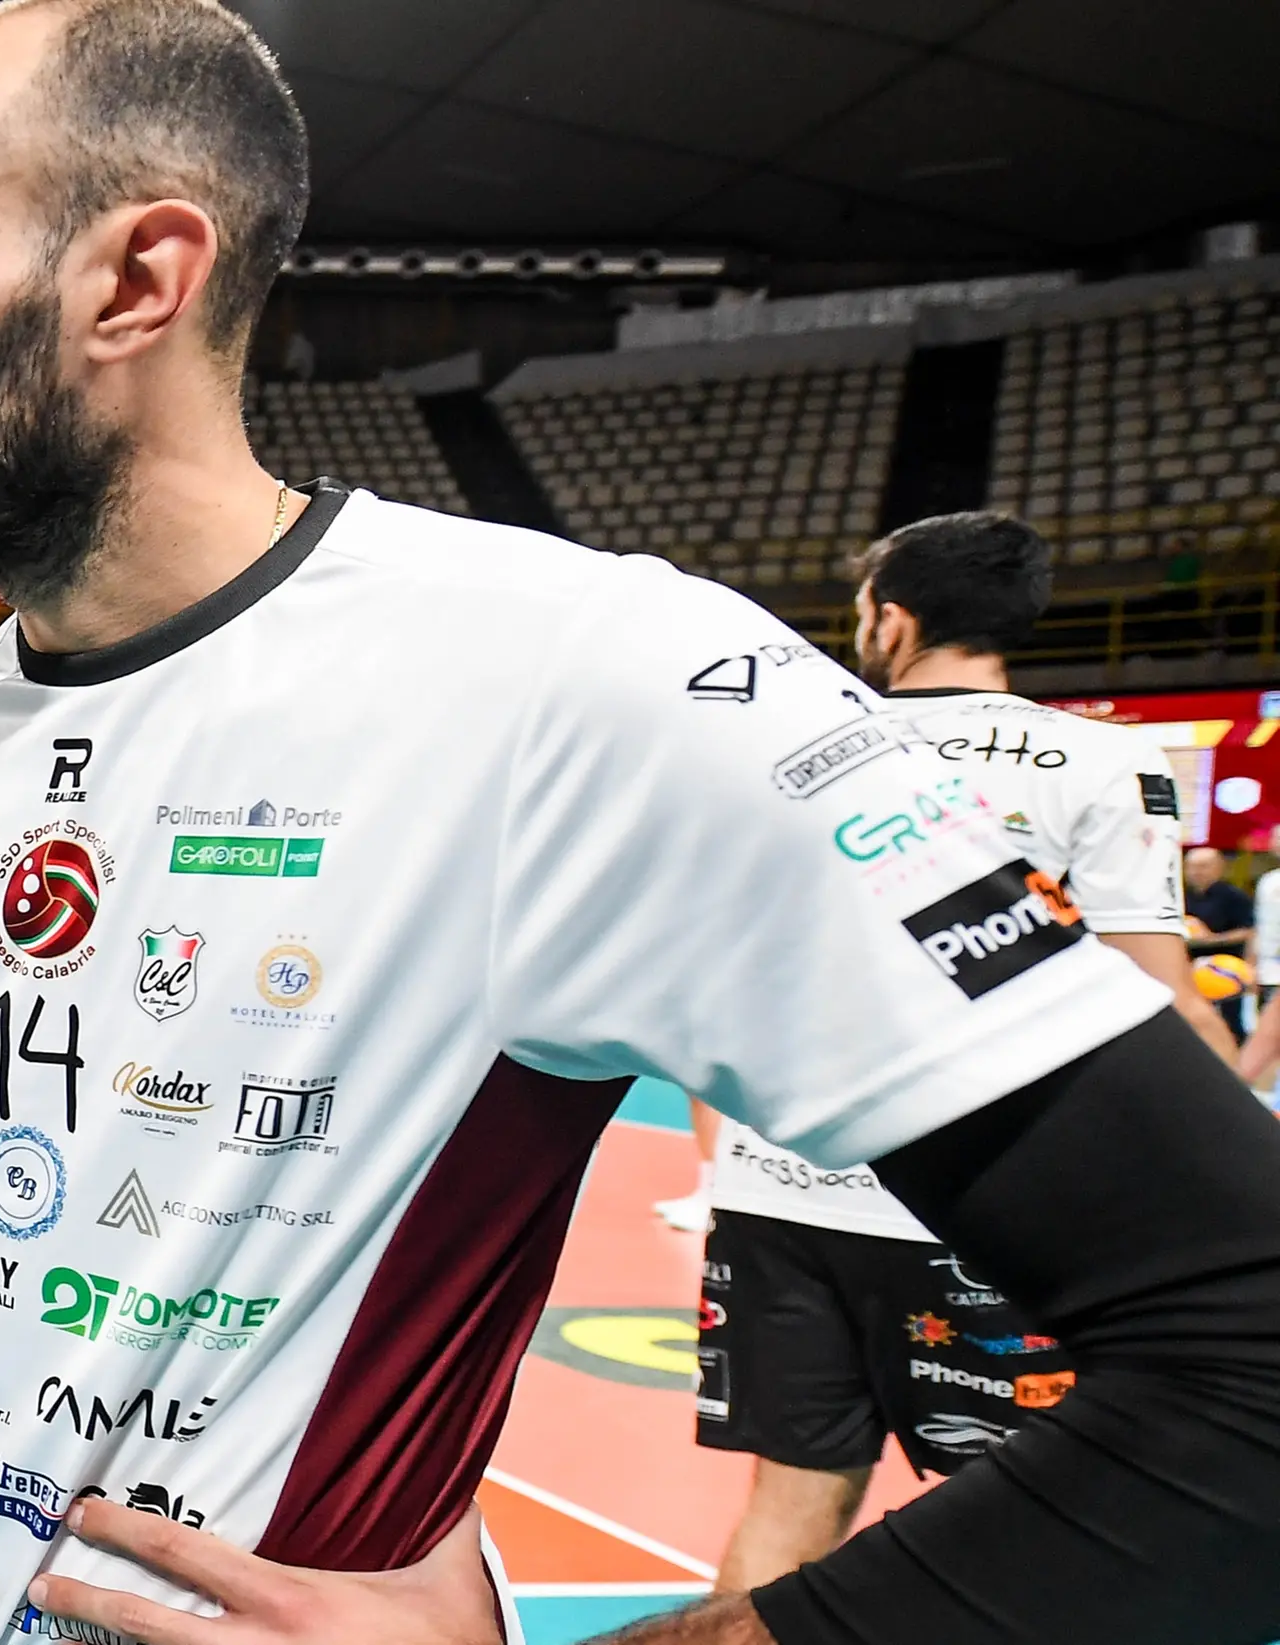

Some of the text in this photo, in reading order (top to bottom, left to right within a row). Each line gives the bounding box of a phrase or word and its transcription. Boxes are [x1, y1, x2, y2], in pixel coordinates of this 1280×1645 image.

[156, 804, 342, 828] Polimeni Porte
[23, 819, 61, 846] Sport
[63, 818, 117, 885] Specialist
[177, 845, 278, 867] GAROFOLI
[921, 893, 1052, 978] Phon
[32, 945, 97, 980] Calabria
[230, 1007, 276, 1019] HOTEL
[113, 1061, 212, 1106] Kordax
[300, 1210, 336, 1228] SRL
[118, 1284, 281, 1329] DOMOTE
